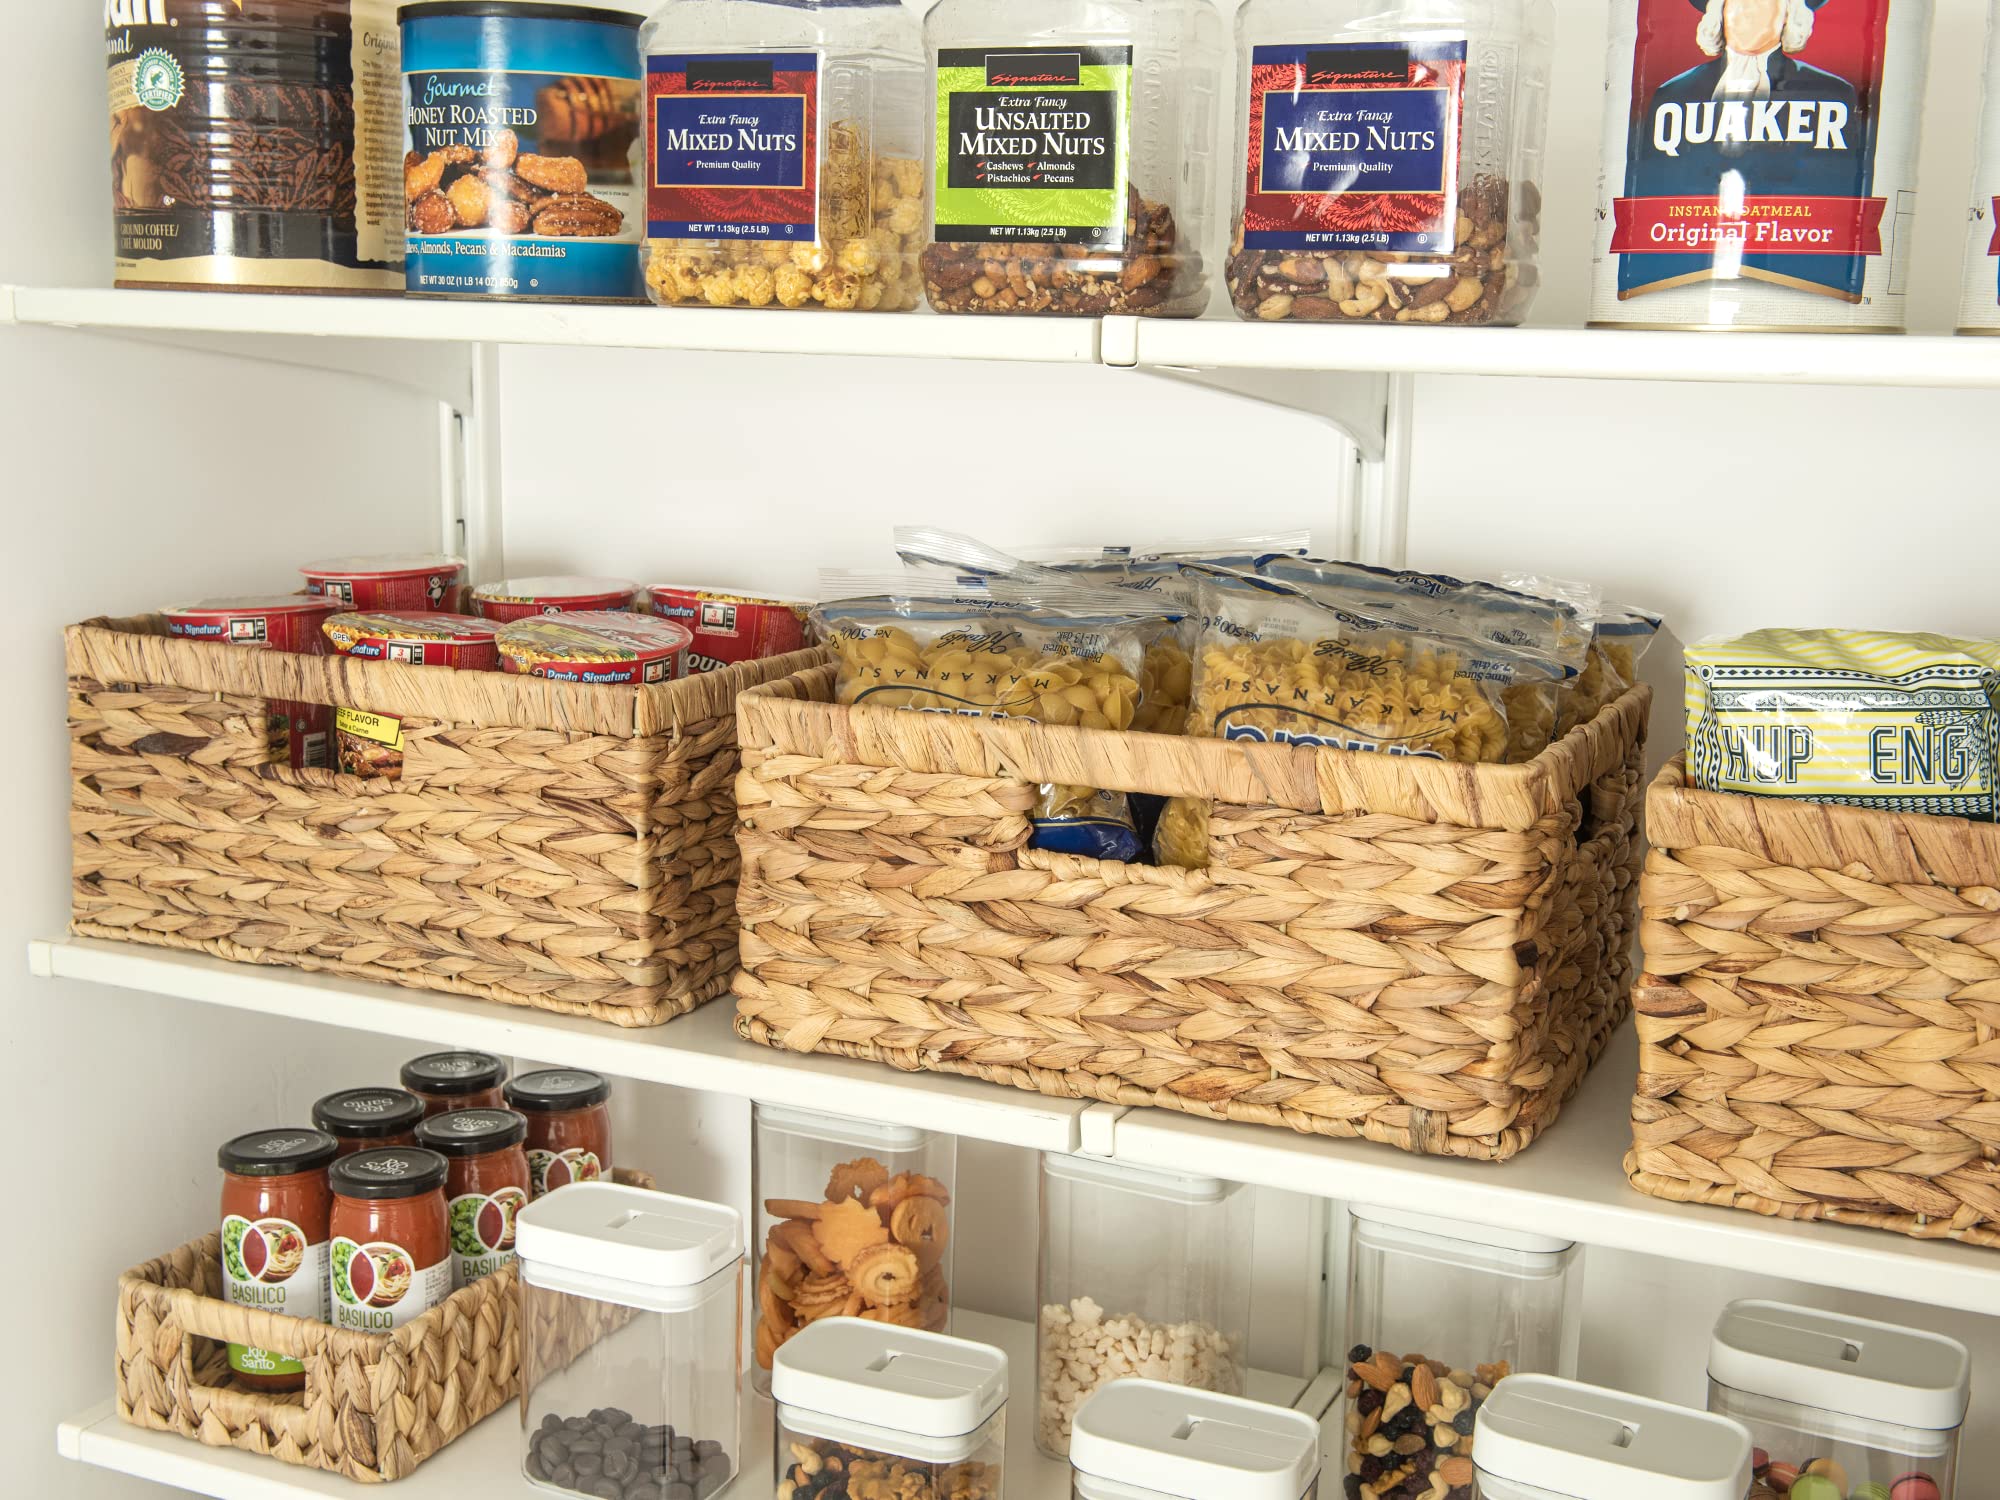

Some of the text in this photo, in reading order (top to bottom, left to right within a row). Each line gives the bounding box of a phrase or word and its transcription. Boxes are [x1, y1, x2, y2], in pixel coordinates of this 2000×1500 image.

[991, 73, 1077, 86] Signature
[1311, 71, 1404, 84] Signature
[424, 75, 500, 105] Gourmet
[692, 79, 769, 91] Signature
[141, 89, 175, 101] CERTIFIED
[998, 96, 1068, 109] Extra Fancy
[408, 104, 537, 126] HONEY ROASTED
[698, 114, 760, 127] Extra Fancy
[975, 107, 1091, 131] UNSALTED
[1317, 110, 1394, 124] Extra Fancy
[1653, 101, 1849, 156] QUAKER
[426, 127, 501, 148] NUT MIX
[667, 128, 796, 152] MIXED NUTS
[958, 132, 1105, 156] MIXED NUTS
[1274, 126, 1435, 151] MIXED NUTS
[696, 160, 761, 171] Premium Quality
[987, 161, 1075, 171] Cashews Almonds
[1313, 162, 1394, 174] Premium Quality
[987, 173, 1074, 183] Pistachios Pecans
[1741, 205, 1812, 217] OATMEAL
[120, 224, 179, 237] GROUND COFFEE/
[688, 224, 770, 235] NET WT 1.13kg (2.5 LB)
[990, 228, 1067, 239] NET WT 1.13kg (2.5 LB)
[1650, 221, 1833, 247] Original Flavor
[1305, 234, 1389, 245] NET WT 1.13kg (2.5 LB)
[420, 240, 453, 256] Almonds,
[455, 241, 487, 256] Pecans
[500, 243, 566, 258] Macadamias
[429, 275, 437, 285] WT
[438, 275, 446, 285] 30
[446, 276, 455, 285] OZ
[464, 277, 474, 286] LB
[475, 277, 484, 286] 14
[711, 609, 718, 618] 3
[185, 624, 222, 636] Signature
[875, 628, 892, 639] Net
[937, 625, 1022, 655] Klasik
[1073, 633, 1100, 645] 11-13
[1041, 644, 1069, 658] Süresi
[1311, 637, 1402, 676] Klasik
[688, 654, 727, 671] OUP
[1492, 663, 1512, 671] 7-9
[582, 667, 631, 684] Signature
[651, 665, 659, 674] 3
[1453, 671, 1484, 682] Süresi
[1224, 677, 1458, 724] MAKARNASI
[1721, 725, 1814, 783] HUP
[1868, 725, 1971, 784] ENG
[343, 1098, 393, 1108] Santo
[359, 1161, 406, 1176] Santo
[232, 1283, 286, 1304] BASILICO
[339, 1306, 393, 1329] BASILICO
[241, 1354, 275, 1370] Santo
